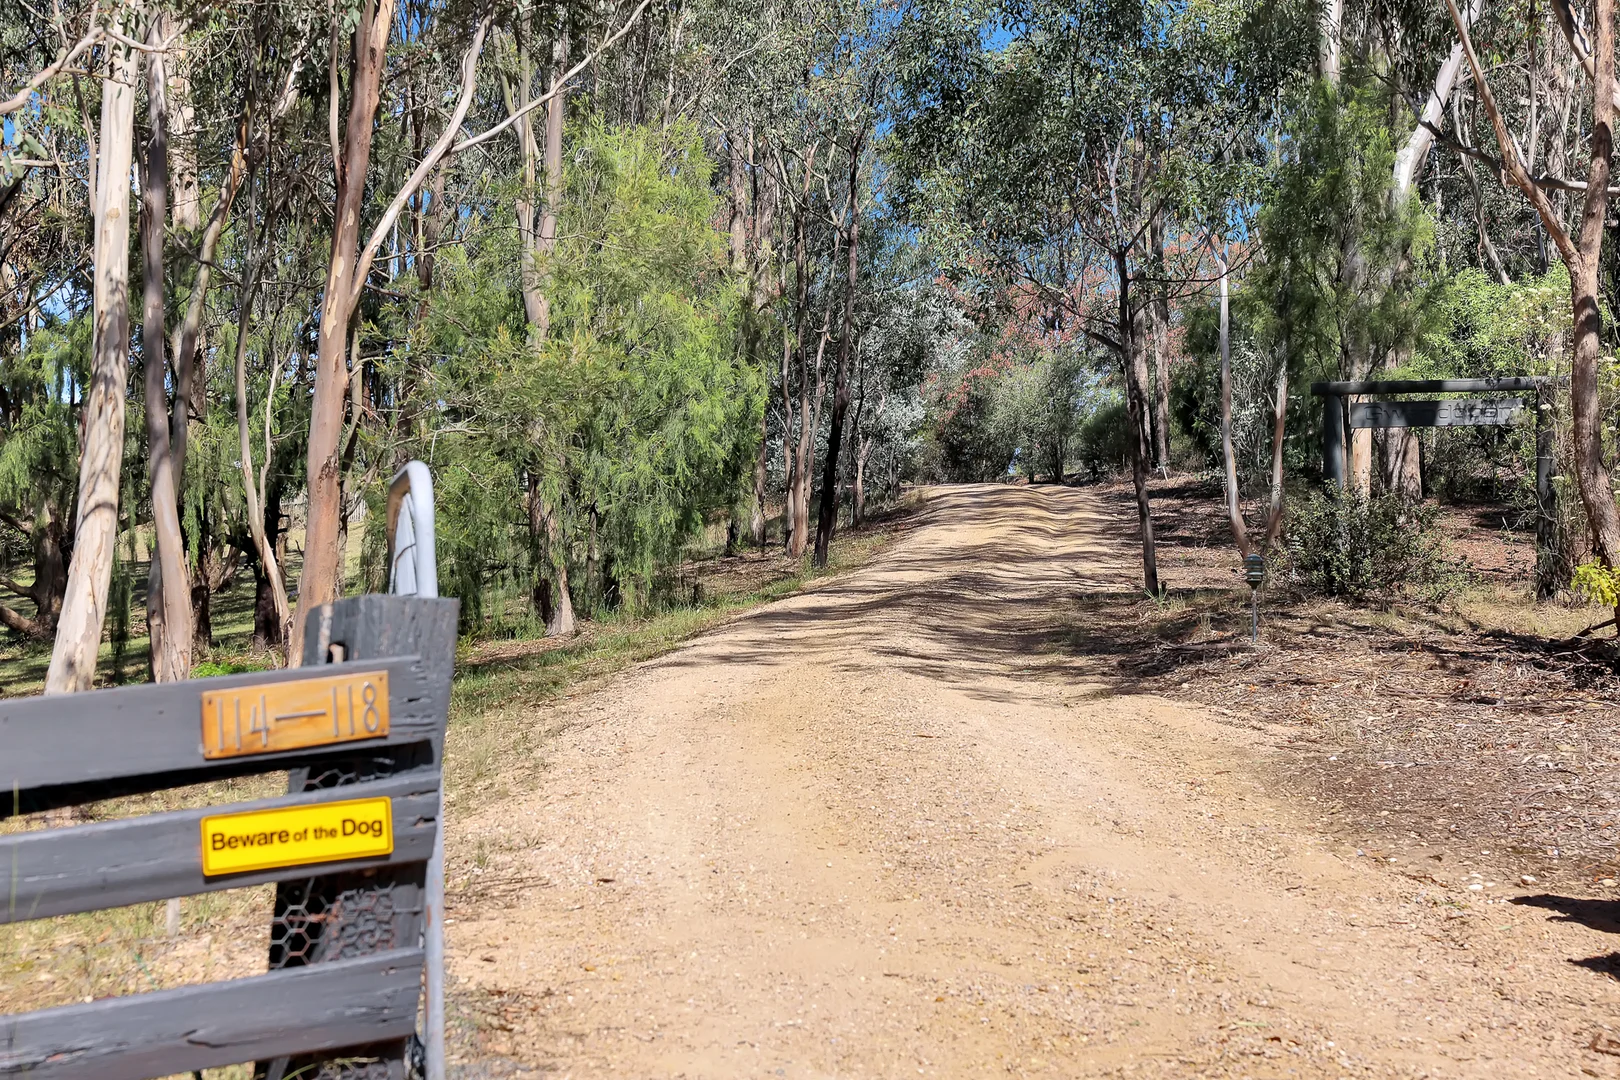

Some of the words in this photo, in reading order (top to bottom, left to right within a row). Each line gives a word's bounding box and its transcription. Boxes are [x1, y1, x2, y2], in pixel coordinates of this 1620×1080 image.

[213, 829, 289, 850] Beware
[293, 827, 309, 842] of
[313, 825, 338, 840] the
[341, 818, 383, 838] Dog
